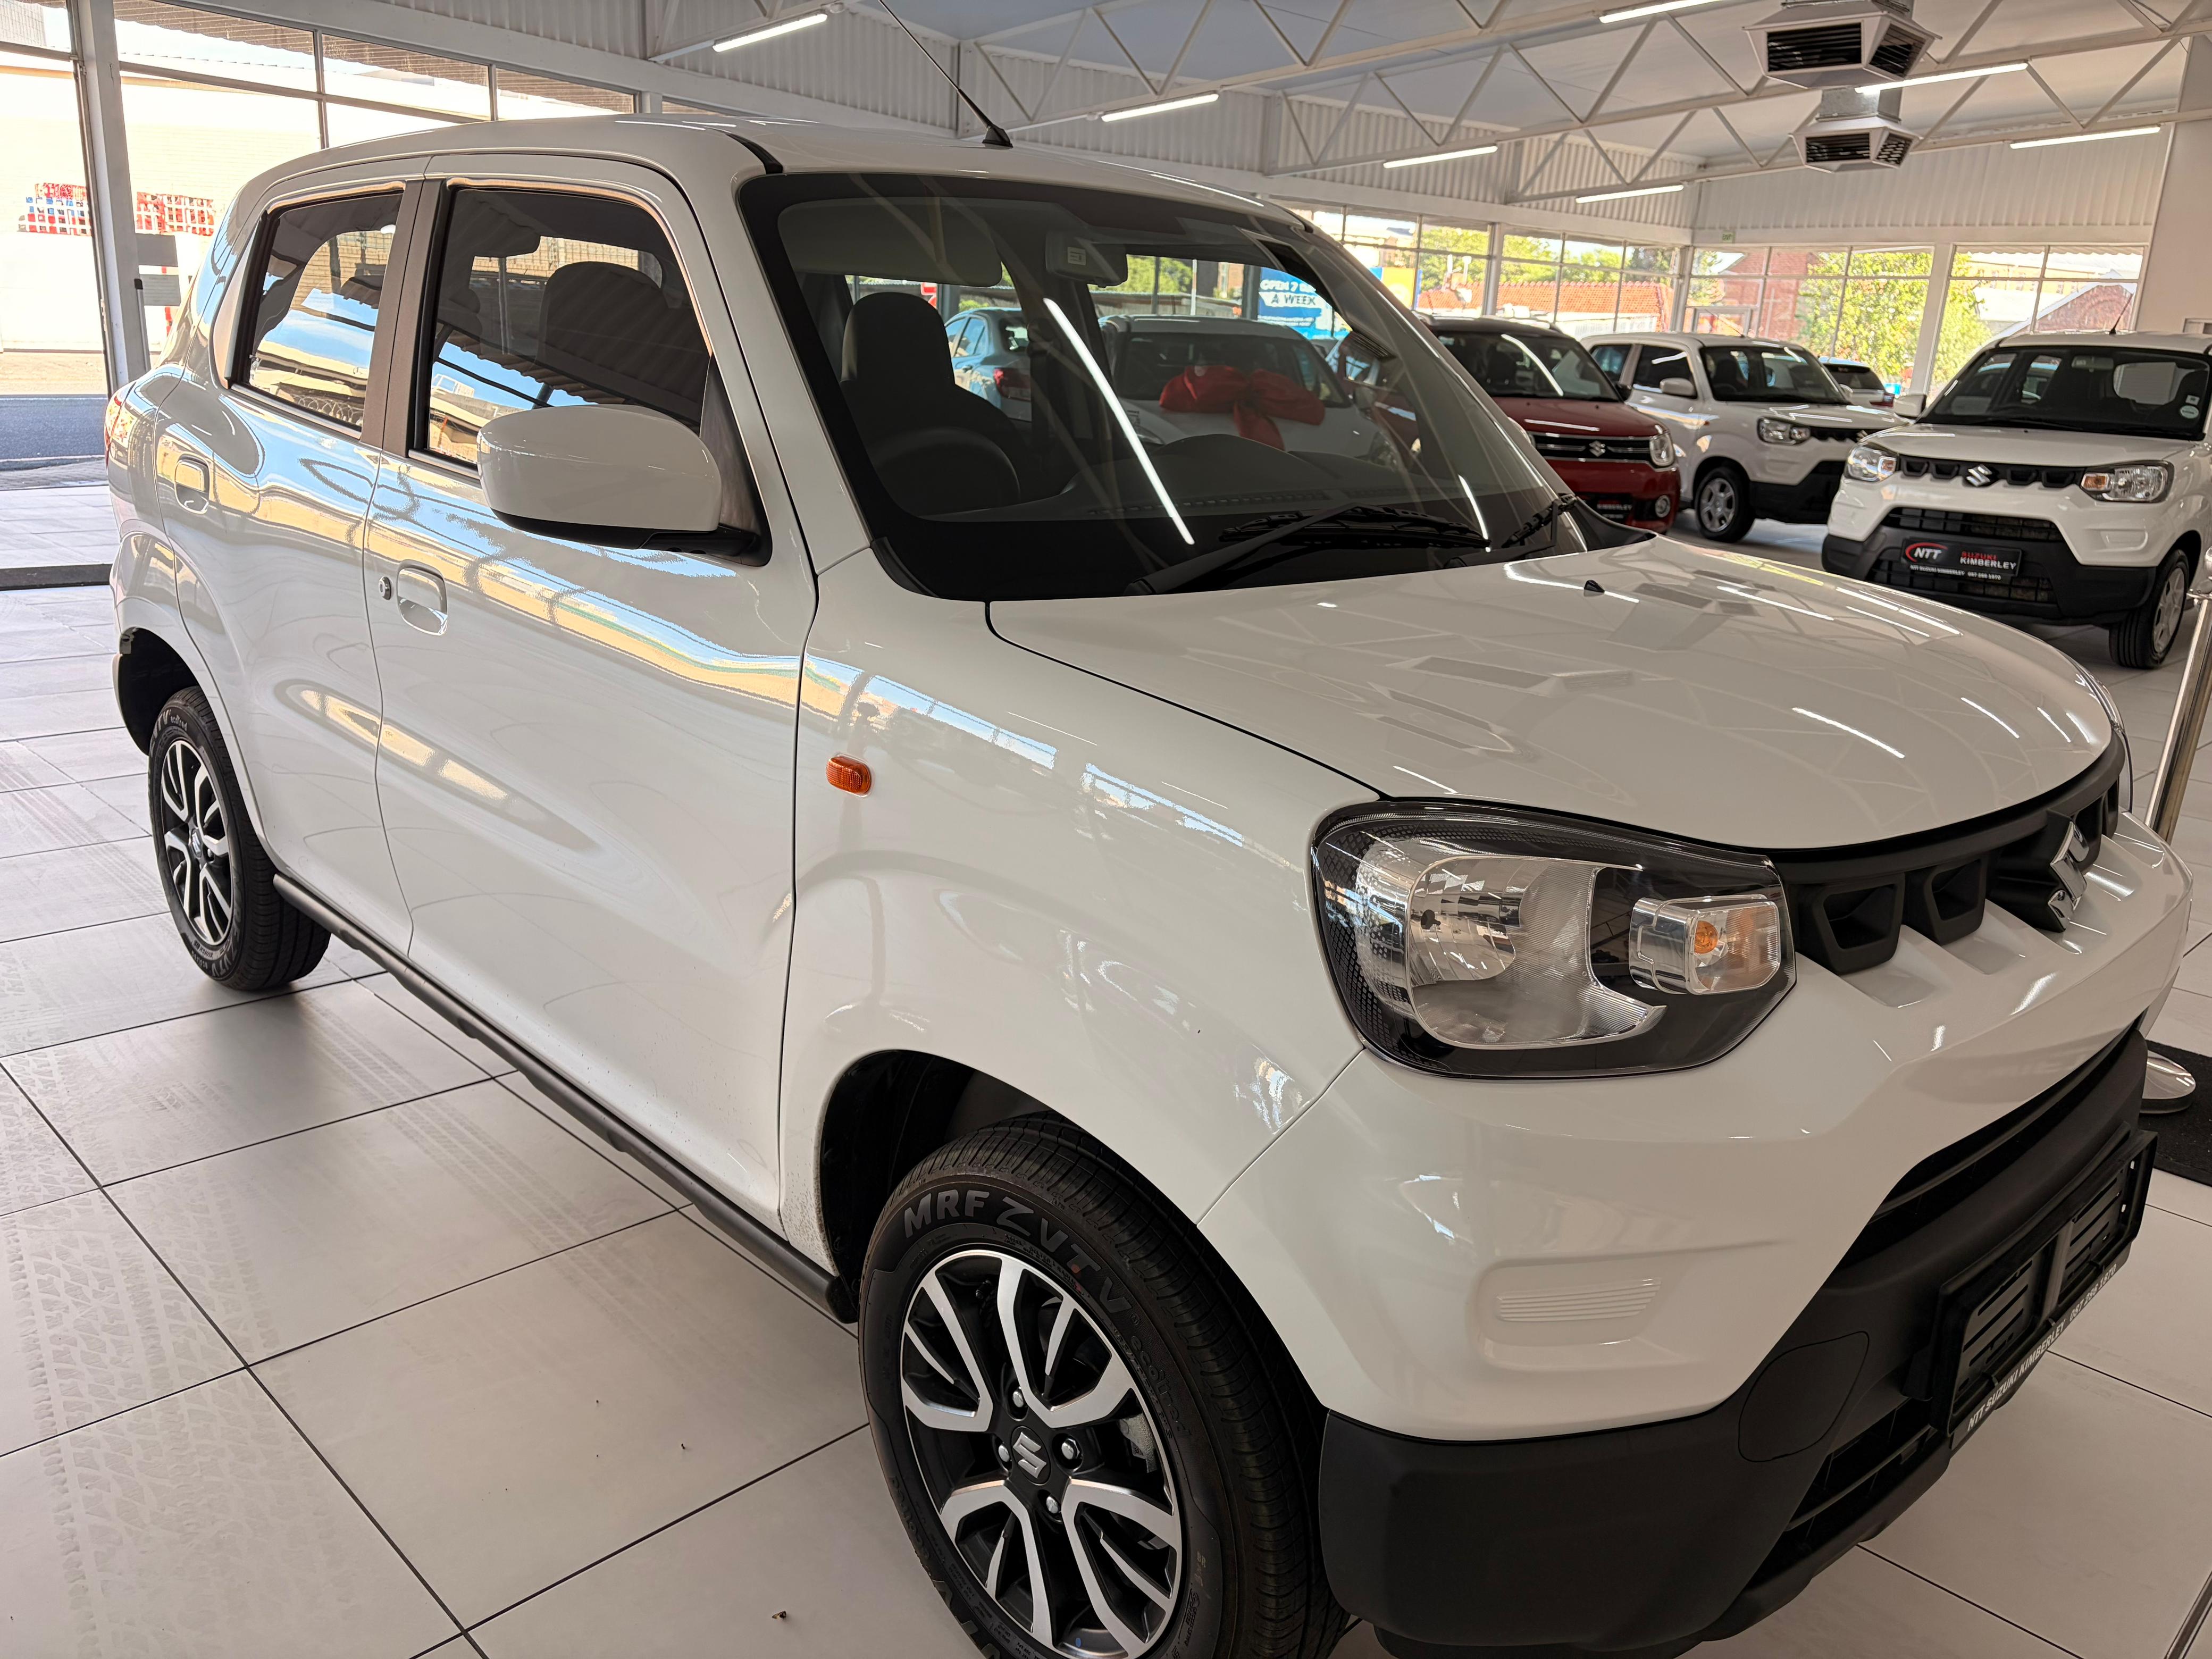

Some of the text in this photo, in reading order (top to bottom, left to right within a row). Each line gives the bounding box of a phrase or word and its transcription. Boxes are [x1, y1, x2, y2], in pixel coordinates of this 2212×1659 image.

[1260, 280, 1289, 290] OPEN
[1291, 282, 1298, 291] 7
[1271, 294, 1316, 305] A WEEK
[1914, 547, 1941, 559] NTT
[1962, 551, 1998, 561] SUZUKI
[1960, 557, 2016, 570] KIMBERLEY
[904, 1188, 990, 1238] MRF
[1967, 1403, 1986, 1432] NTT
[1985, 1368, 2019, 1412] SUZUKI
[2019, 1318, 2067, 1377] KIMBERLEY
